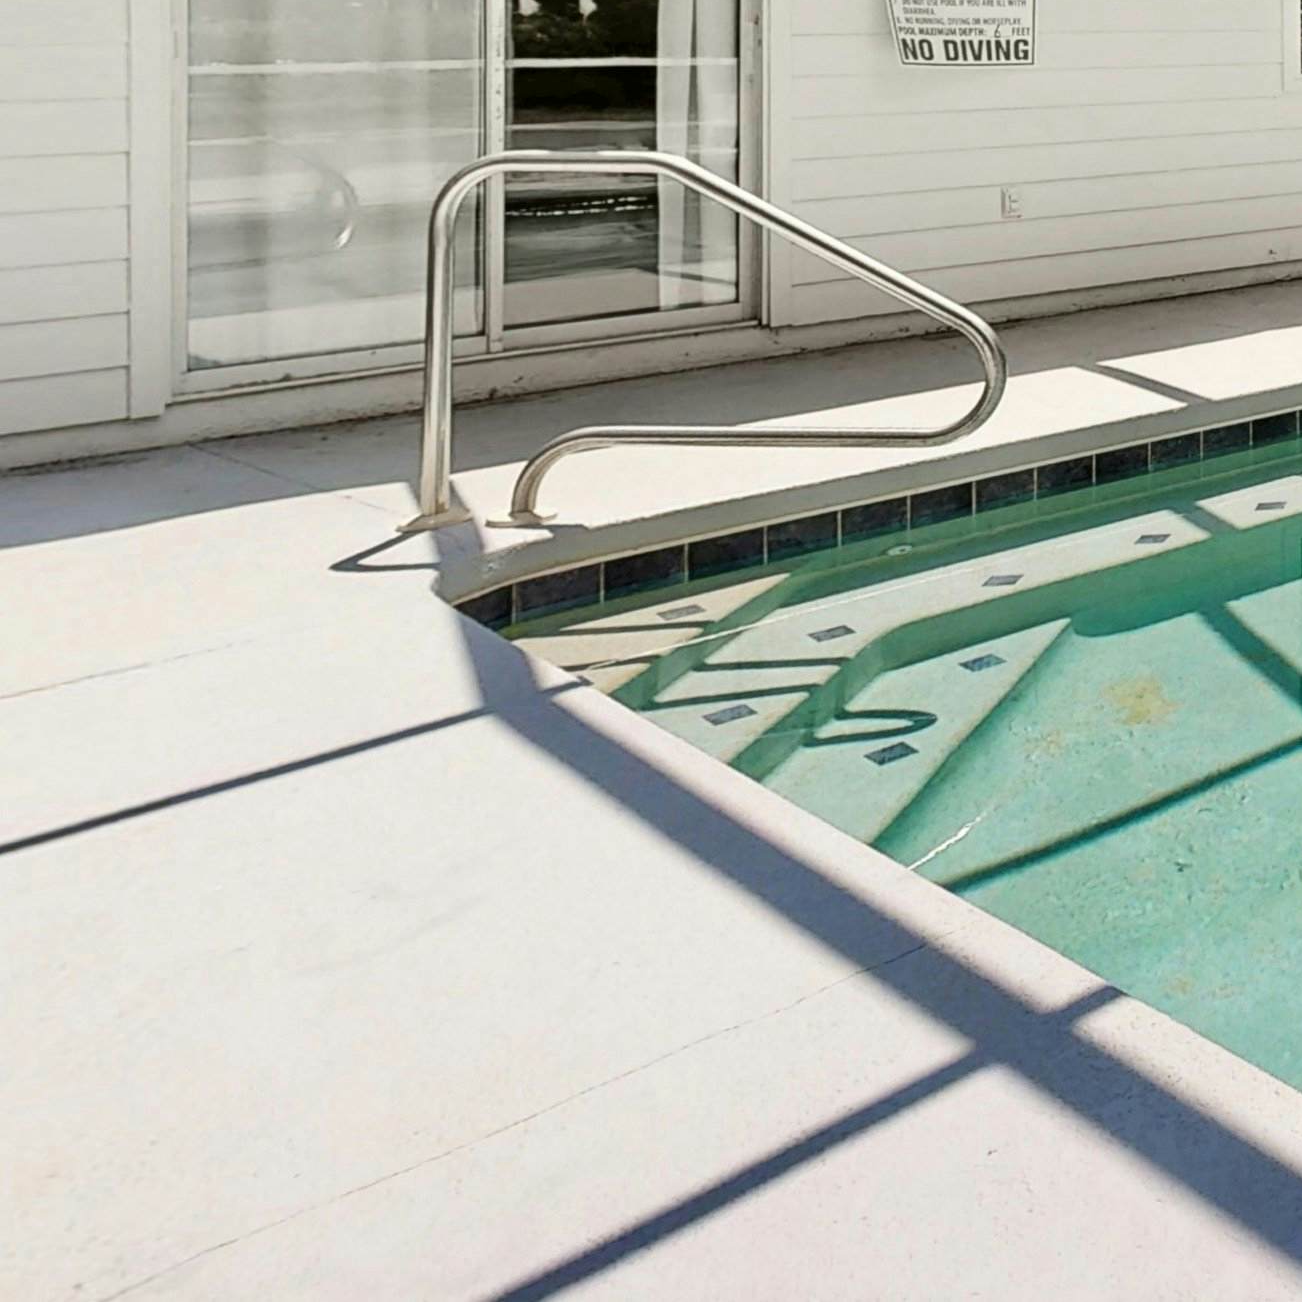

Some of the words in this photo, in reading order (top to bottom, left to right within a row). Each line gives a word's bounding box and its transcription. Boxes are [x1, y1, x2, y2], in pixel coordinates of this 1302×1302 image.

[966, 0, 981, 7] YOU
[982, 0, 995, 7] ARE
[1007, 0, 1027, 8] WITH
[947, 17, 970, 25] DIVING
[899, 26, 917, 35] POOL
[918, 27, 957, 36] MAXIMUM
[994, 23, 1002, 39] 6
[1011, 26, 1030, 36] FEET
[901, 38, 935, 61] NO
[942, 38, 1030, 62] DIVING
